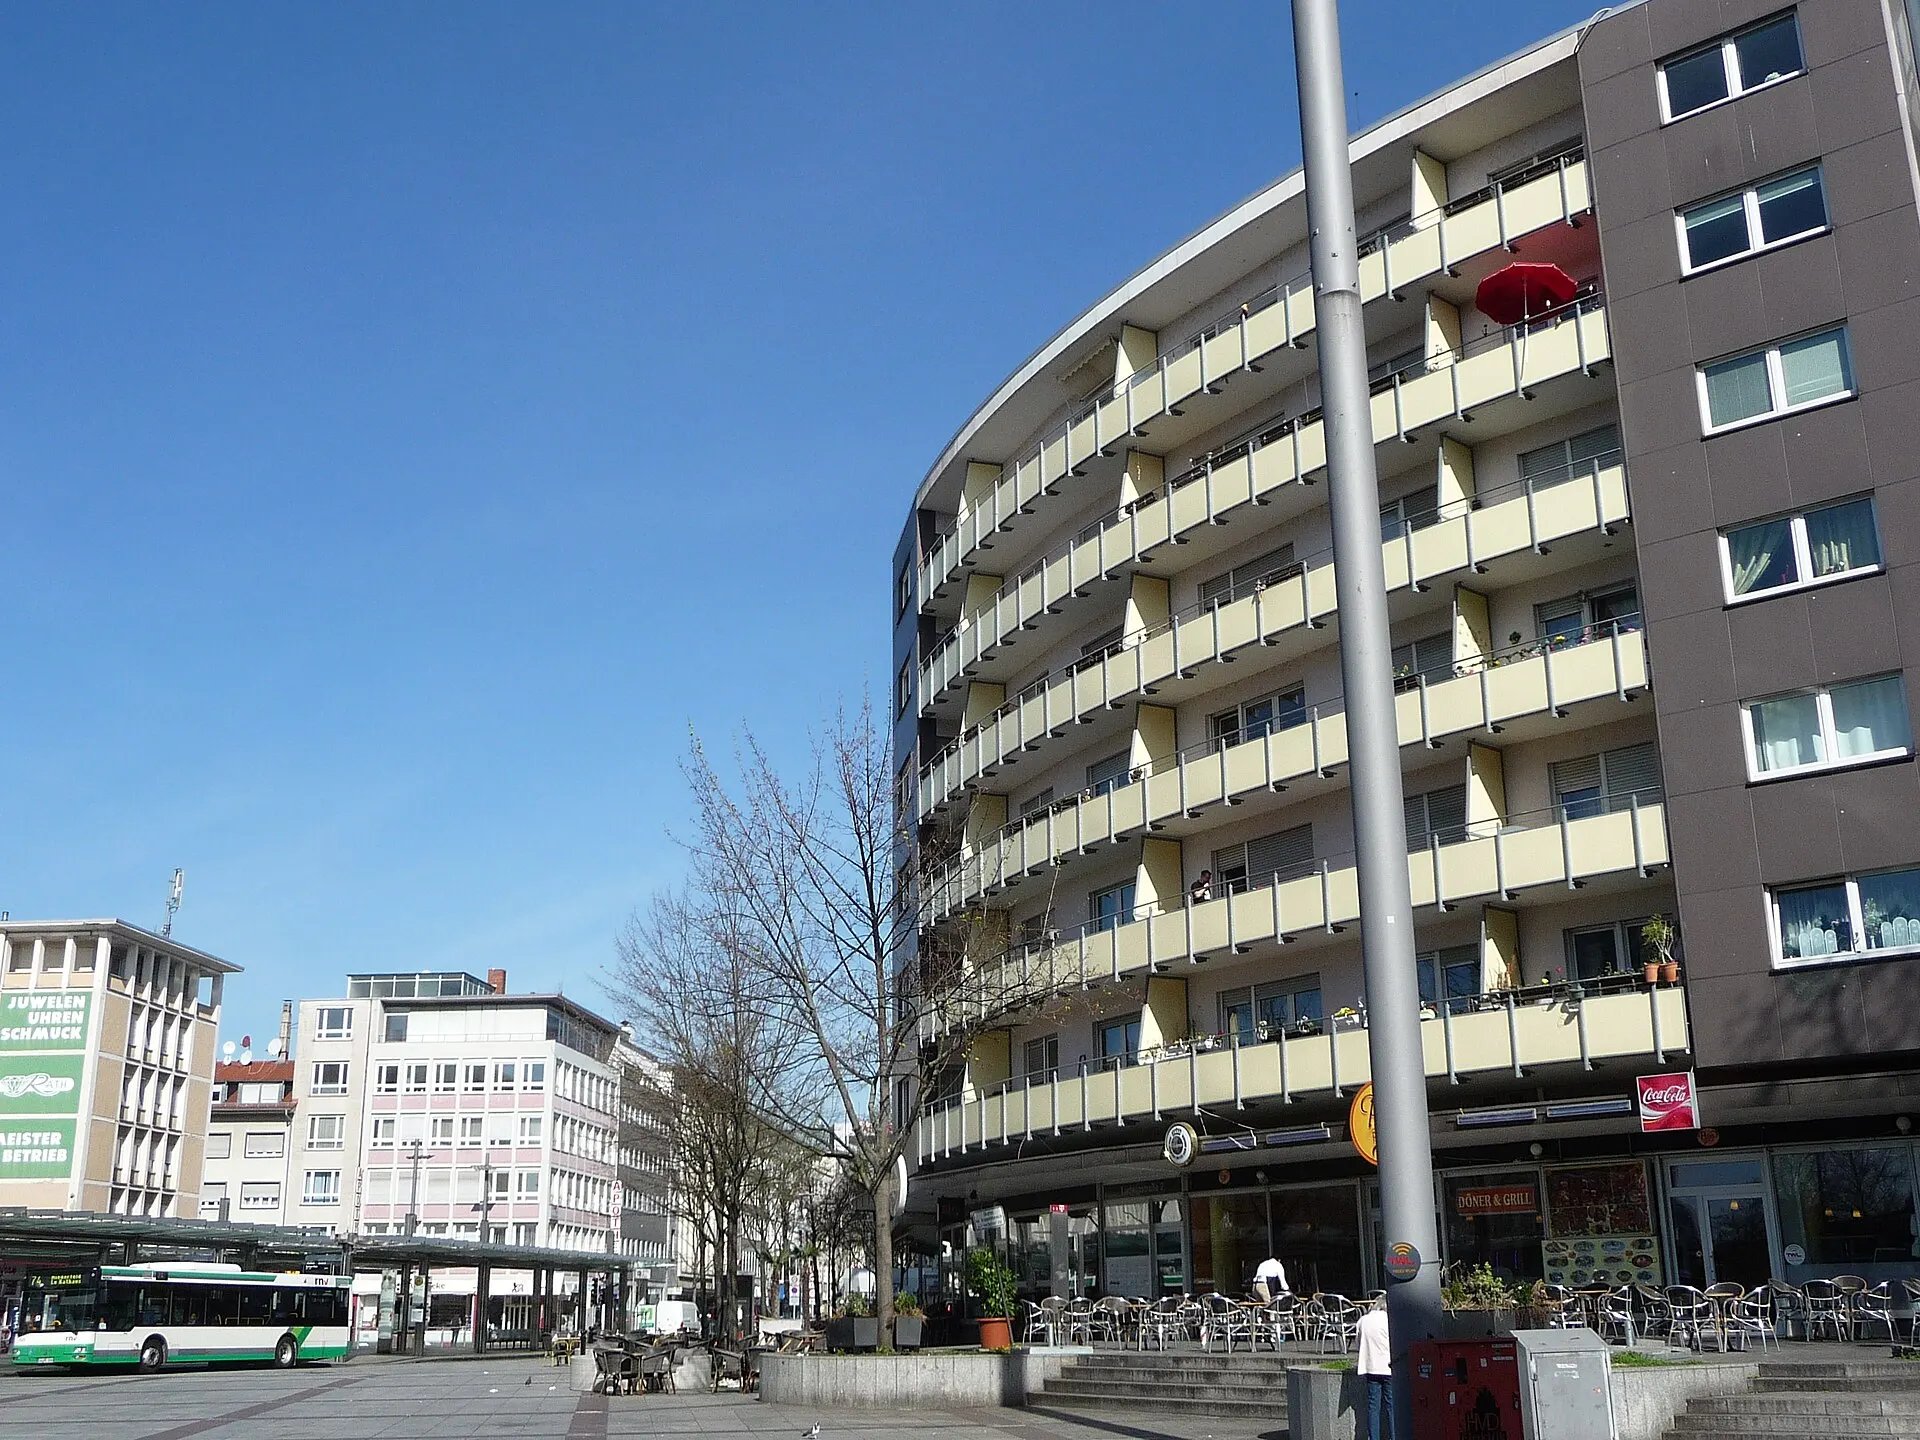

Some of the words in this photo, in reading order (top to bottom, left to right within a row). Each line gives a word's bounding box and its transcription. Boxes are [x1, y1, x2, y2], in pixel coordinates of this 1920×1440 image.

[8, 996, 86, 1009] JUWELEN
[28, 1011, 84, 1025] UHREN
[1, 1027, 82, 1040] SCHMUCK
[1643, 1085, 1687, 1104] Coca-Cola
[2, 1149, 67, 1162] BETRIEB
[1458, 1193, 1492, 1208] DÖNER
[1494, 1194, 1501, 1206] &
[1503, 1192, 1532, 1206] GRILL
